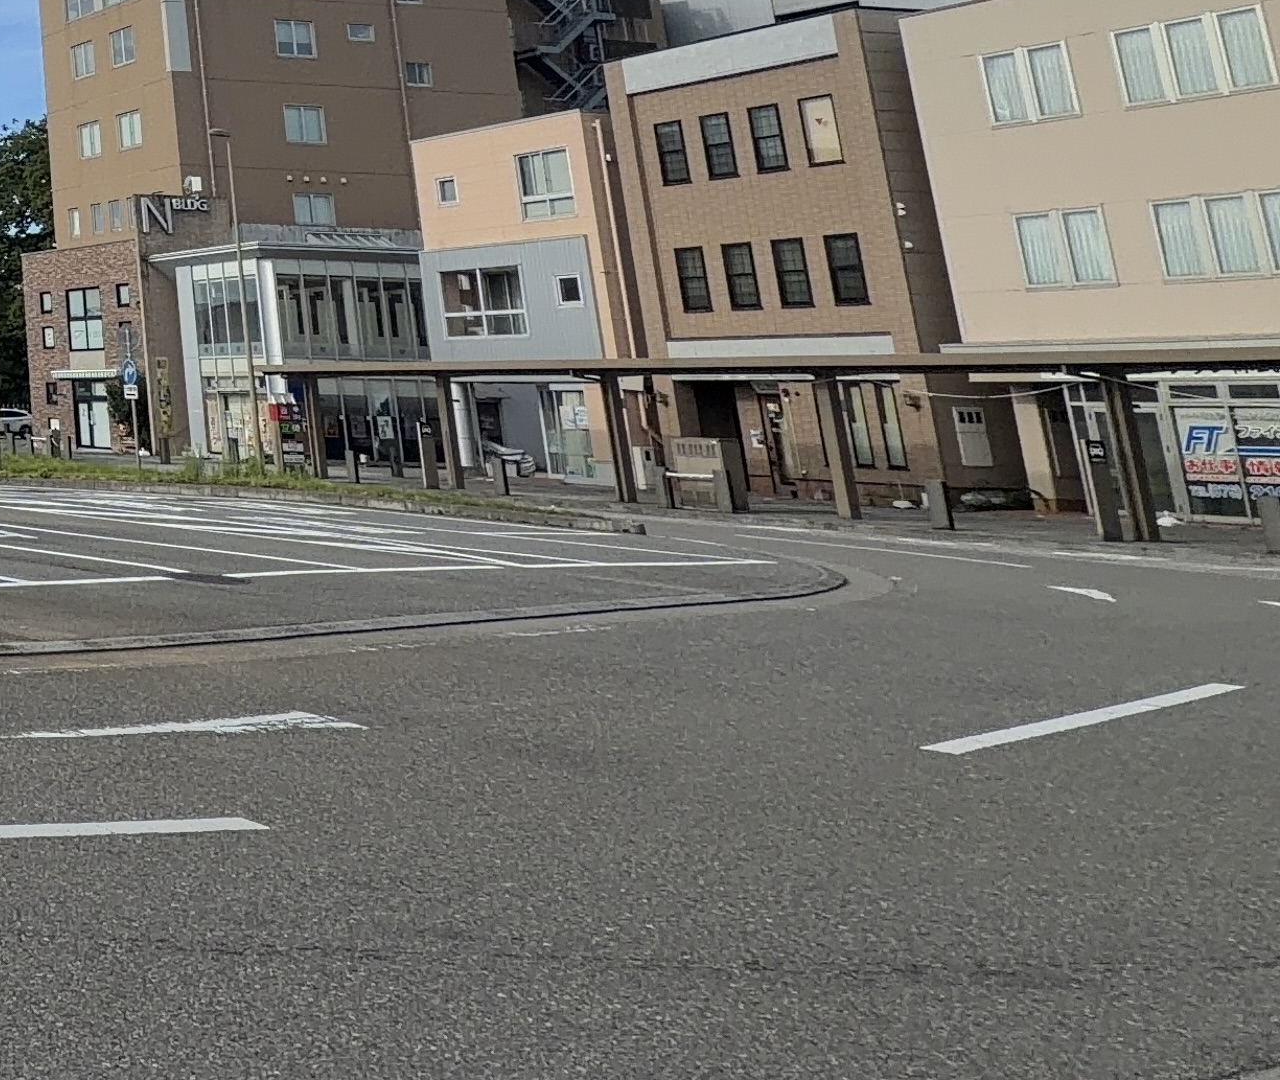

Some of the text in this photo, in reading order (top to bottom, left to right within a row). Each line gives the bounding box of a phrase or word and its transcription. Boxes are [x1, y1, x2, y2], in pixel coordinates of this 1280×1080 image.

[141, 197, 209, 234] N BLDG
[1184, 425, 1226, 454] FT
